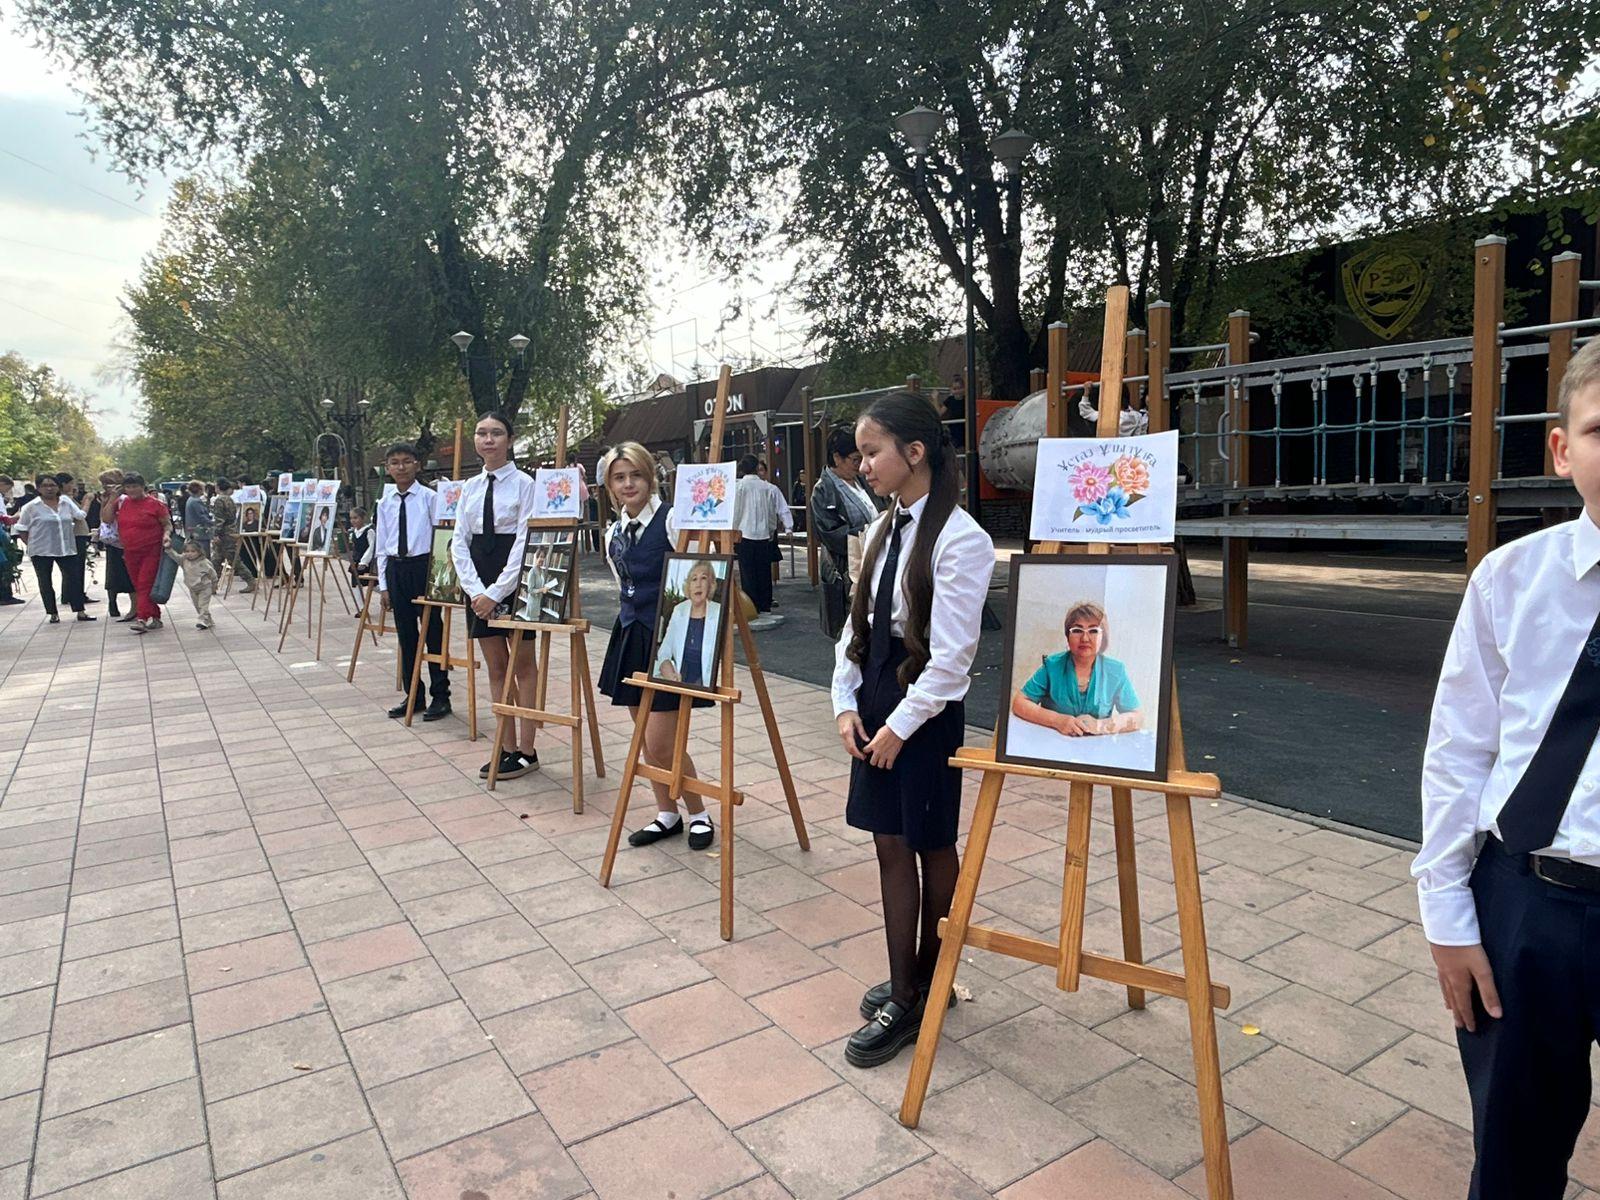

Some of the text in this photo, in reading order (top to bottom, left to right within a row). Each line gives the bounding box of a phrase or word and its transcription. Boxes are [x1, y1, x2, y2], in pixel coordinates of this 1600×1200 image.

[704, 394, 743, 416] OON
[1085, 526, 1114, 535] мудрый
[1115, 524, 1161, 534] просветитель
